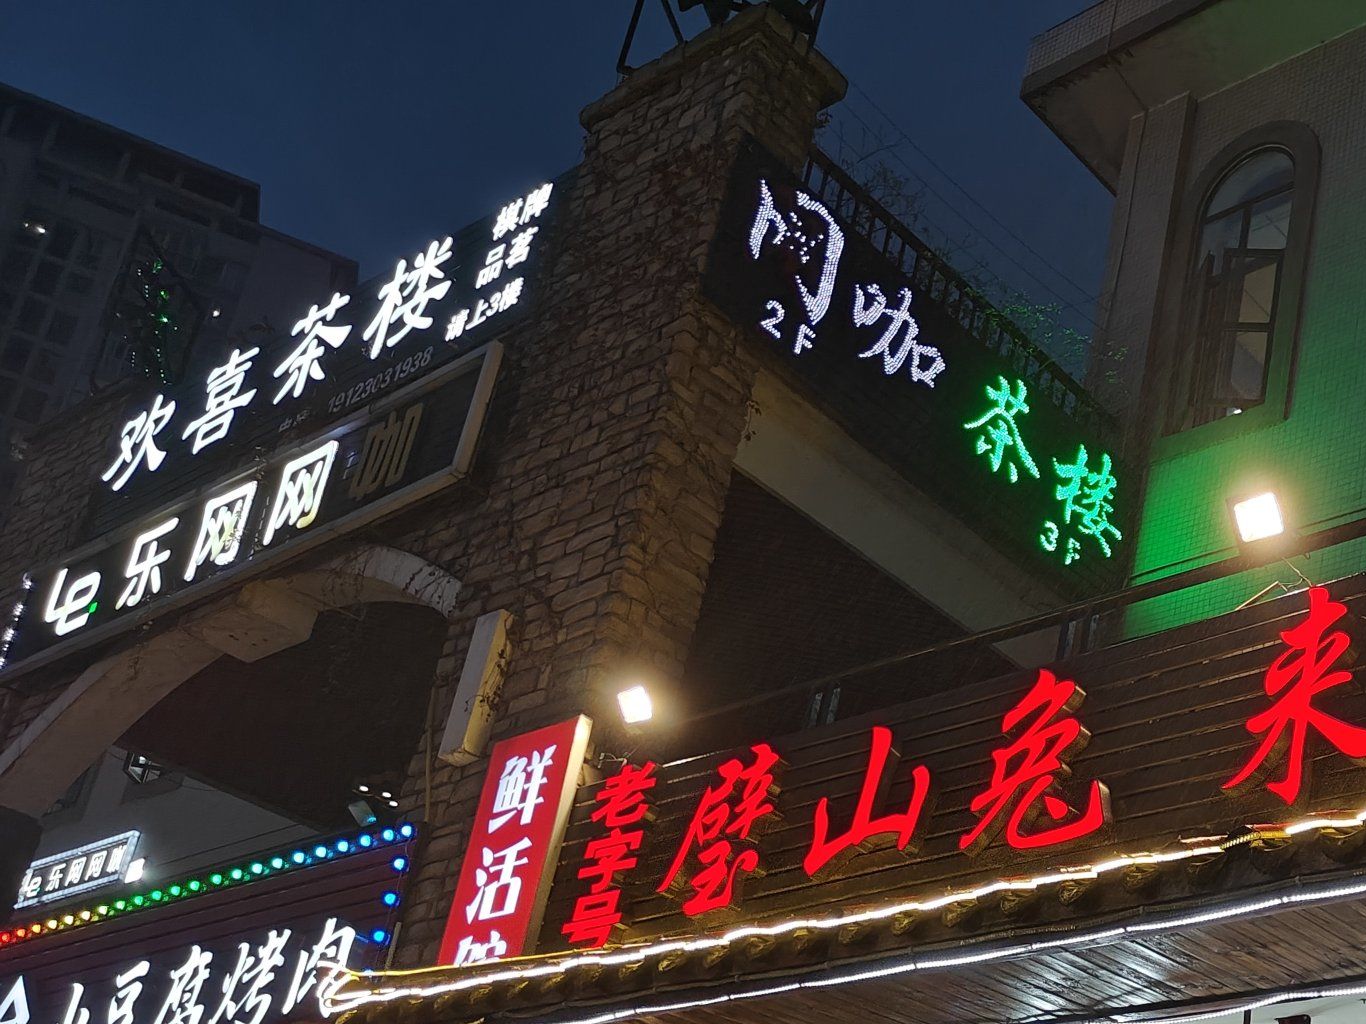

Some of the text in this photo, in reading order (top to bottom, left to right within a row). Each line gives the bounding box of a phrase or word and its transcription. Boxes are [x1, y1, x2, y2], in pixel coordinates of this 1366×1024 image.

[476, 226, 539, 289] 品茗
[445, 277, 525, 342] 请上3楼
[760, 300, 817, 355] 2F
[102, 237, 454, 491] 欢喜茶楼
[328, 346, 434, 414] 19123031938
[657, 668, 1105, 916] 璧山兔
[561, 759, 656, 947] 老字号
